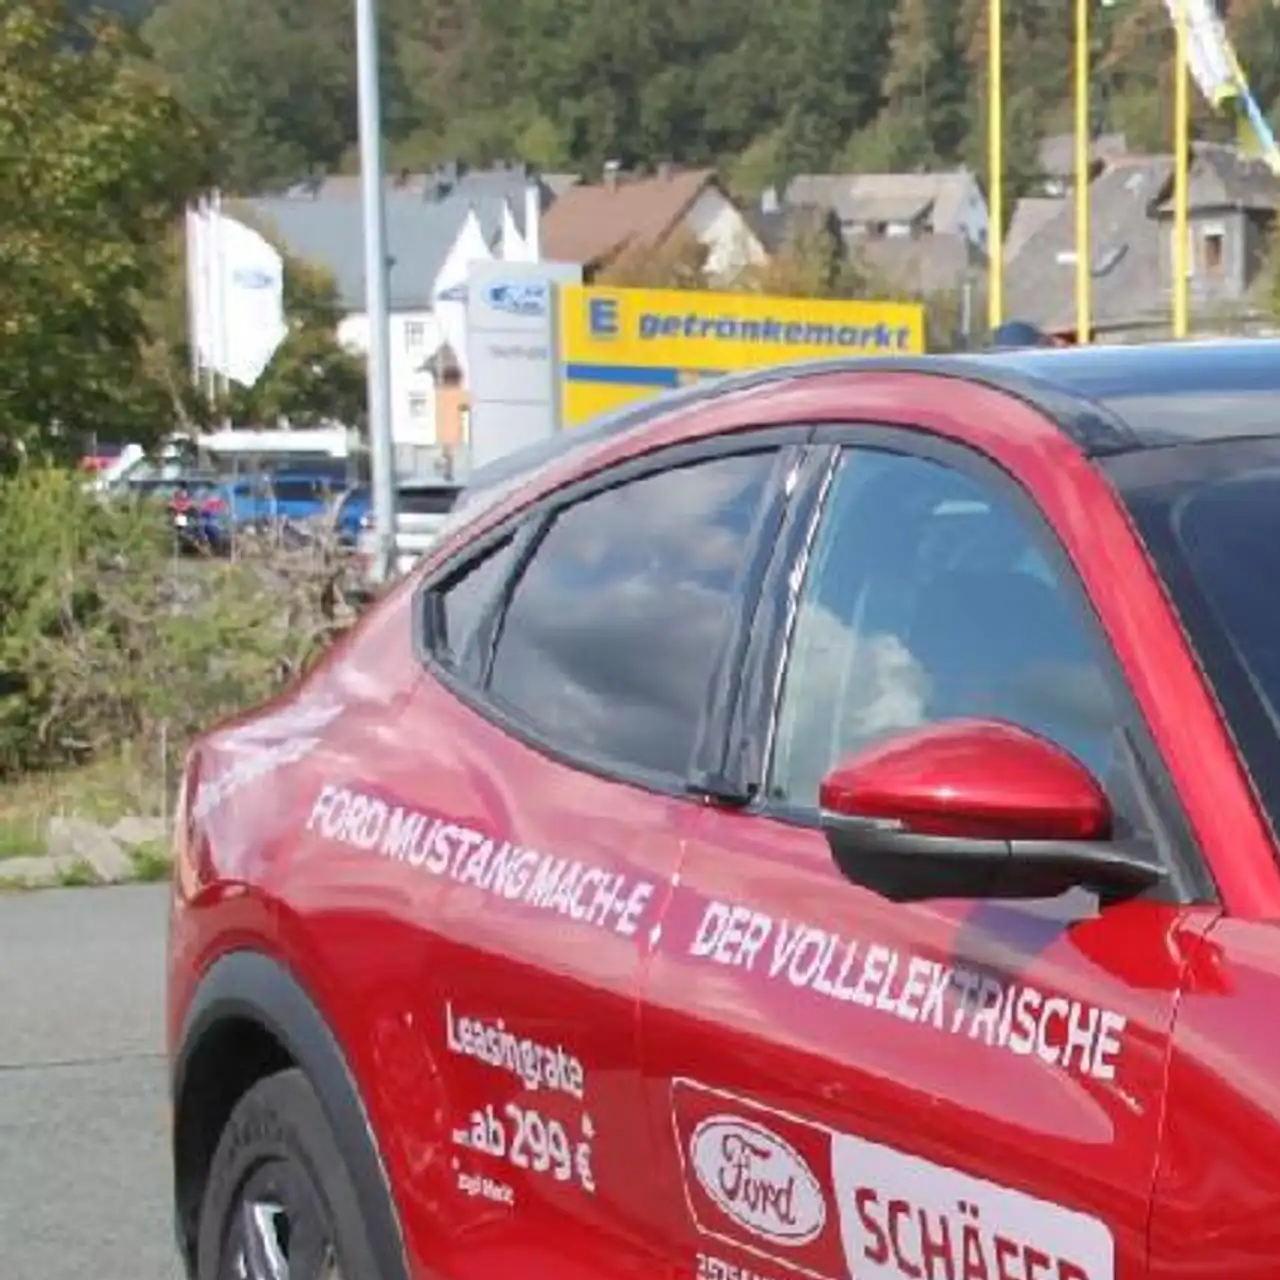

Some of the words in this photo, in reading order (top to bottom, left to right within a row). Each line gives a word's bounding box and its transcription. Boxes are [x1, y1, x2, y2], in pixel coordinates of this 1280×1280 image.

[590, 298, 618, 334] E
[306, 785, 381, 850] FORD
[379, 806, 538, 899] MUSTANG
[690, 901, 768, 969] DER
[766, 918, 1127, 1079] VOLLELEKTRISCHE
[446, 1000, 584, 1099] Leasingrate
[471, 1104, 505, 1156] ab
[505, 1104, 571, 1180] 299
[719, 1133, 797, 1226] Ford
